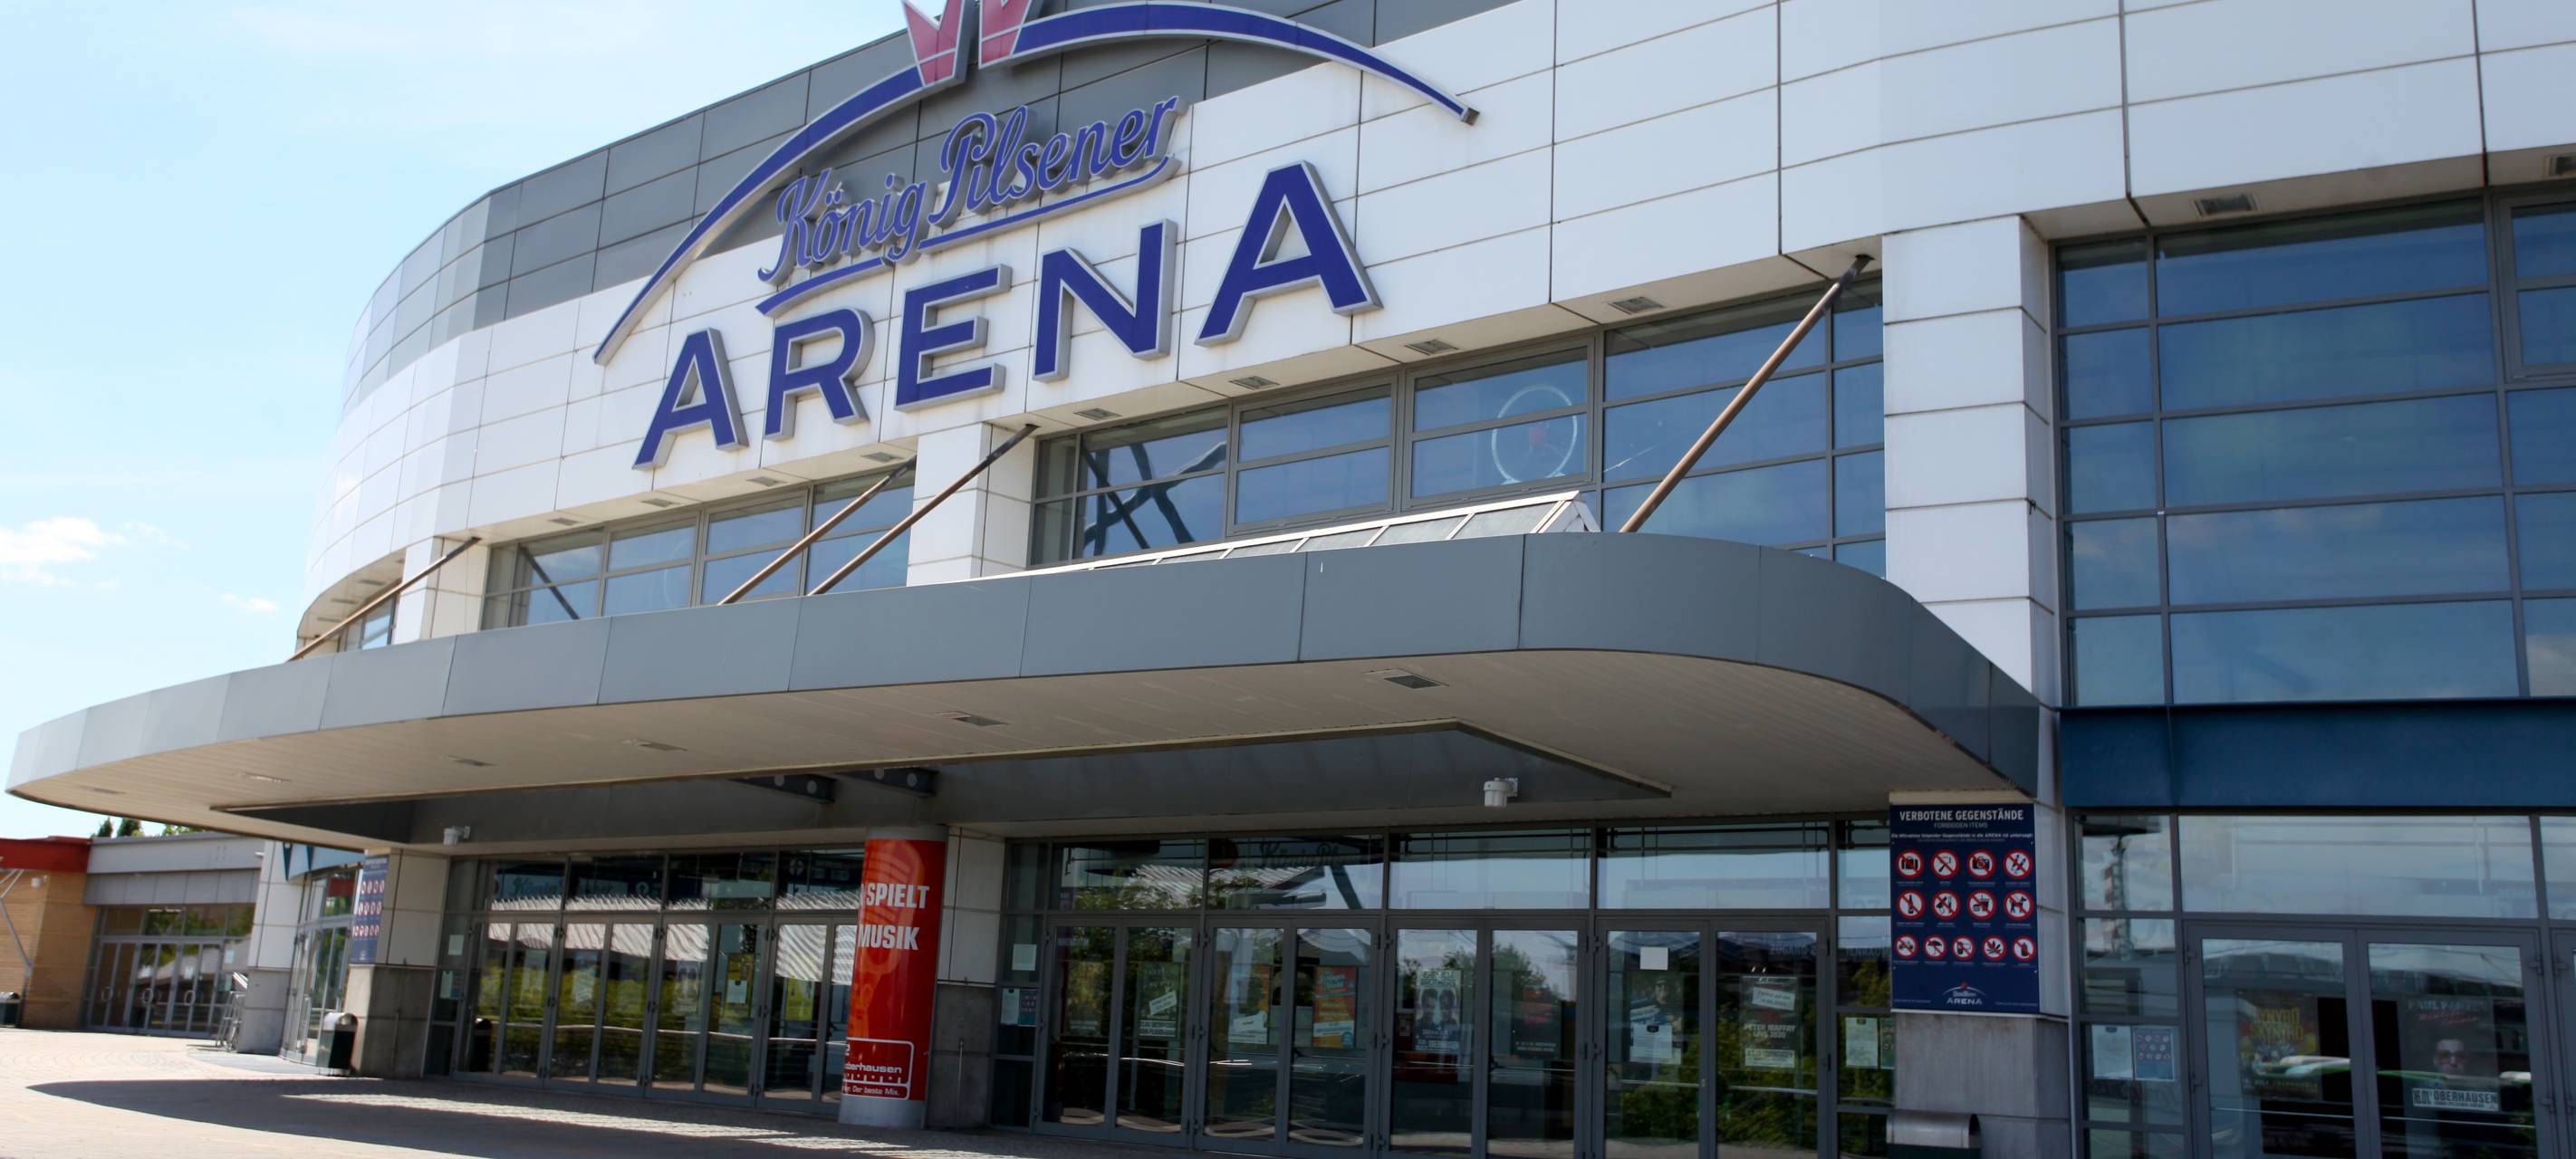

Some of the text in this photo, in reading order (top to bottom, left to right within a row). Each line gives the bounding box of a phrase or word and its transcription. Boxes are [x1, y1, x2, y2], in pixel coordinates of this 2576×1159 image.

[756, 94, 1188, 286] König Pilsener
[631, 159, 1384, 472] ARENA
[1899, 809, 2024, 821] VERBOTENE GEGENSTÄNDE
[866, 883, 930, 909] SPIELT
[858, 924, 920, 951] MUSIK
[1946, 997, 1983, 1005] ARENA
[2434, 1090, 2497, 1104] OBERHAUSEN
